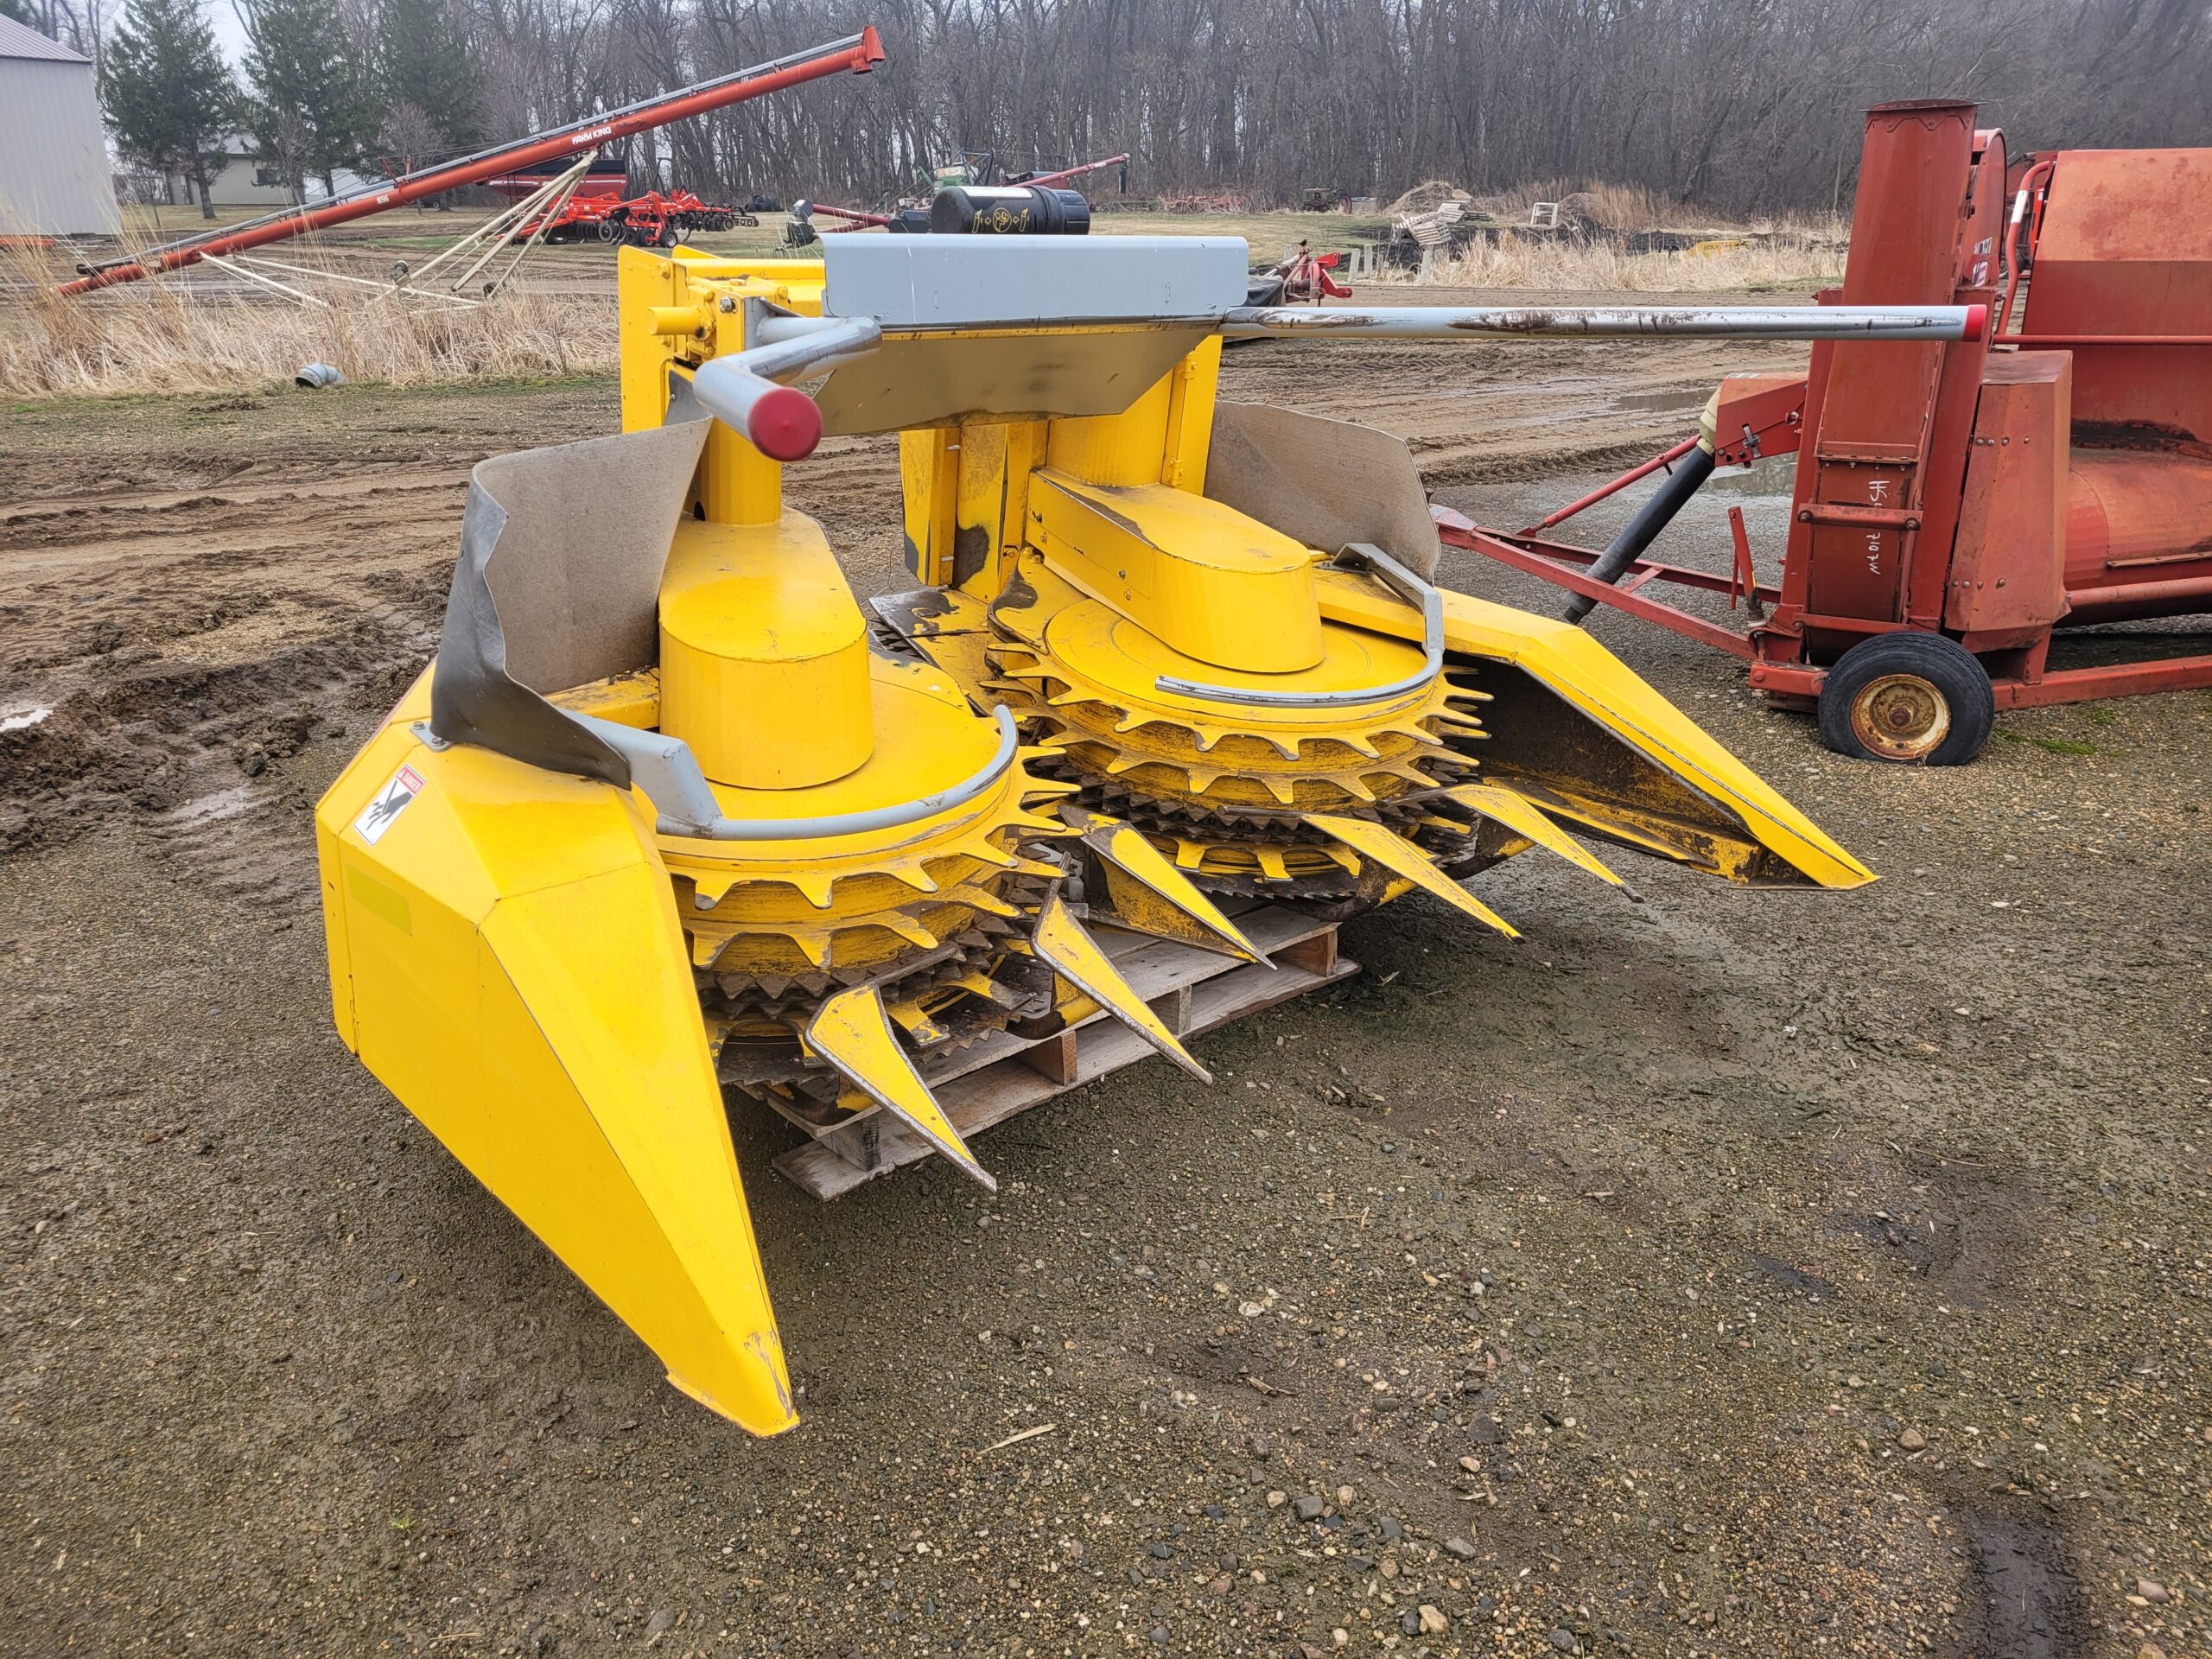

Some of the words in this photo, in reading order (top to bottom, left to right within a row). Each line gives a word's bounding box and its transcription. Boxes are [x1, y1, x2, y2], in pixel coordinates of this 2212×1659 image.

[572, 132, 593, 145] FARM
[593, 126, 612, 138] KING
[377, 194, 389, 204] 856
[403, 772, 422, 791] DANGER
